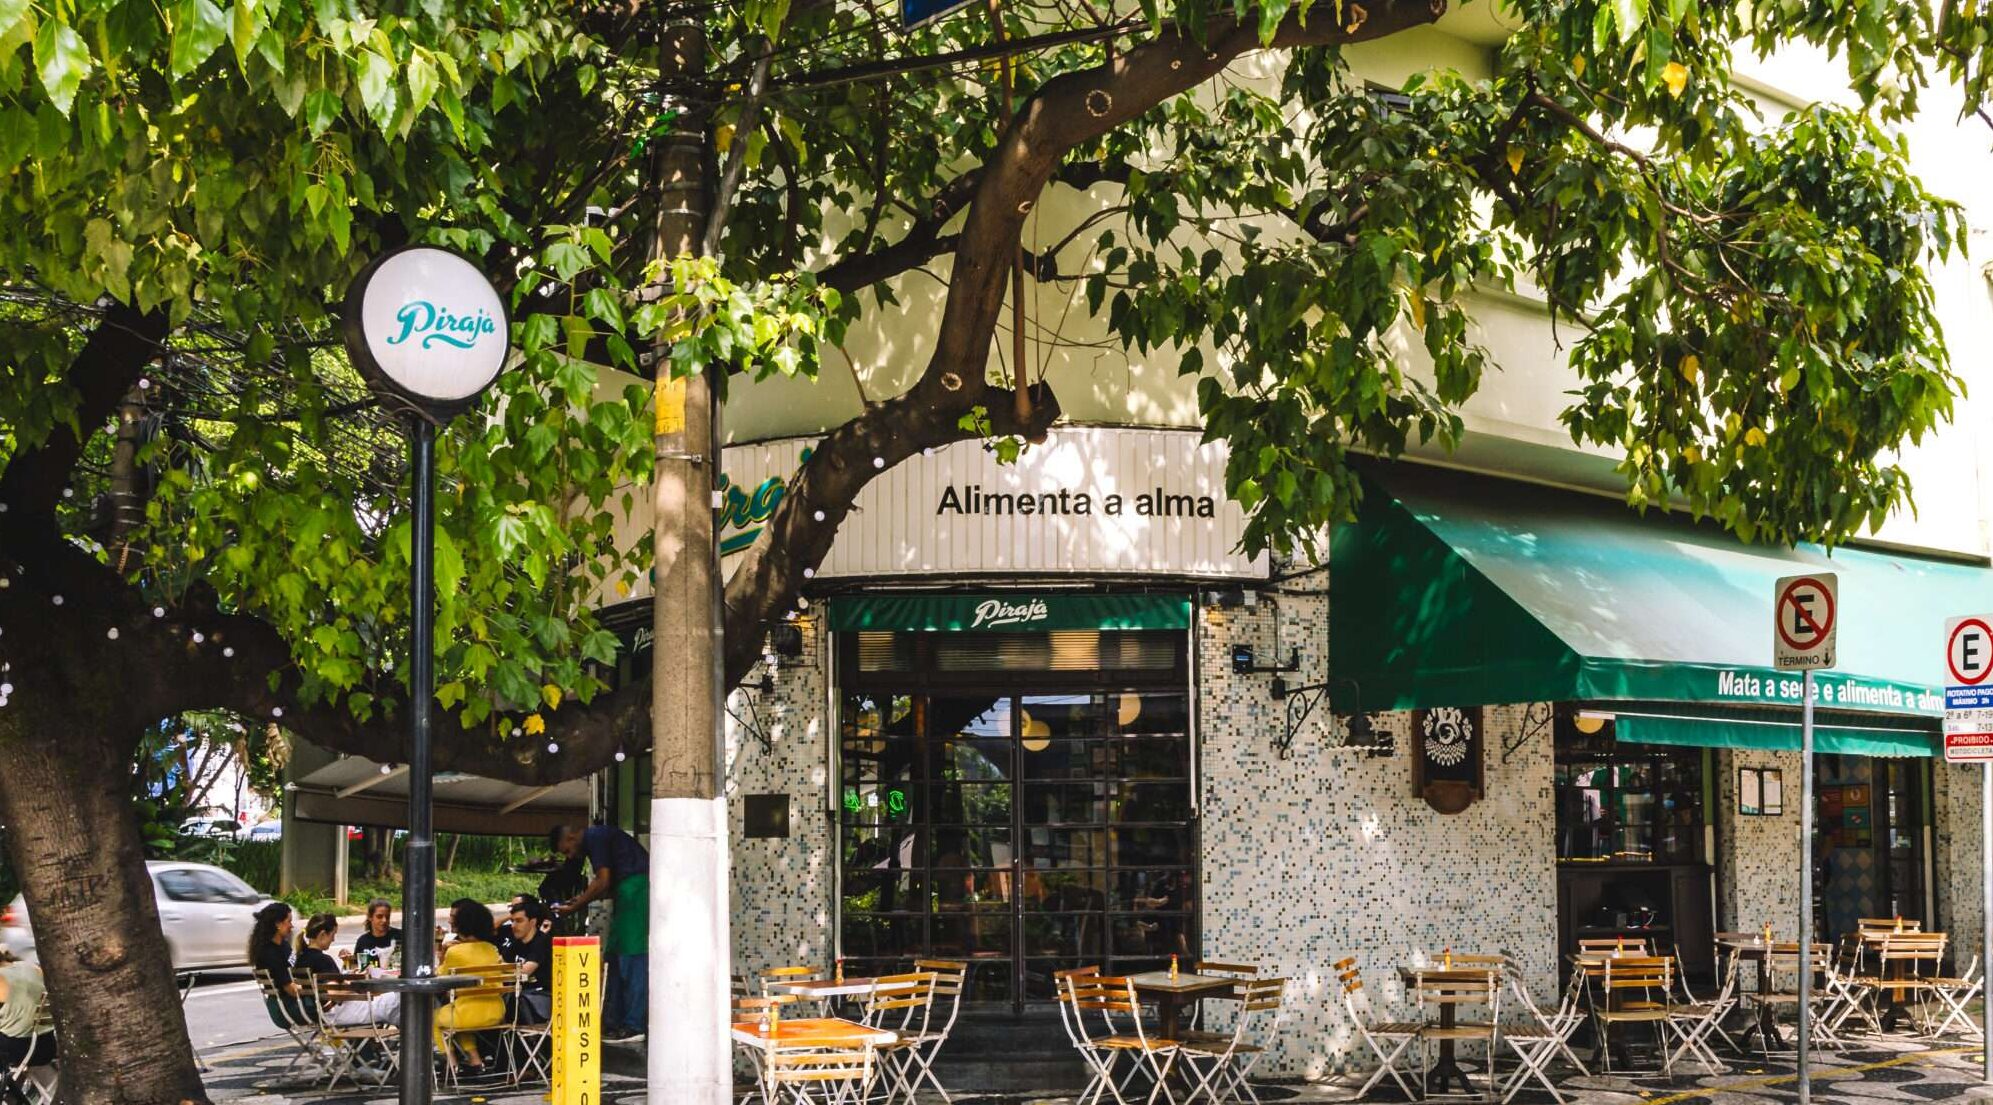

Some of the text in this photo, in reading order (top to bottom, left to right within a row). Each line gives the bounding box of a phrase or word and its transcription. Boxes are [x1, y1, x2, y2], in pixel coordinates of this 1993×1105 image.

[386, 300, 496, 349] Pirajá
[936, 485, 1215, 518] Alimenta a alma
[970, 597, 1048, 629] Pirajá
[1963, 634, 1979, 670] E
[1718, 671, 1760, 697] Mata
[1765, 679, 1776, 697] a
[1823, 682, 1834, 701] e
[1837, 679, 1901, 707] alimenta
[1905, 691, 1915, 708] a
